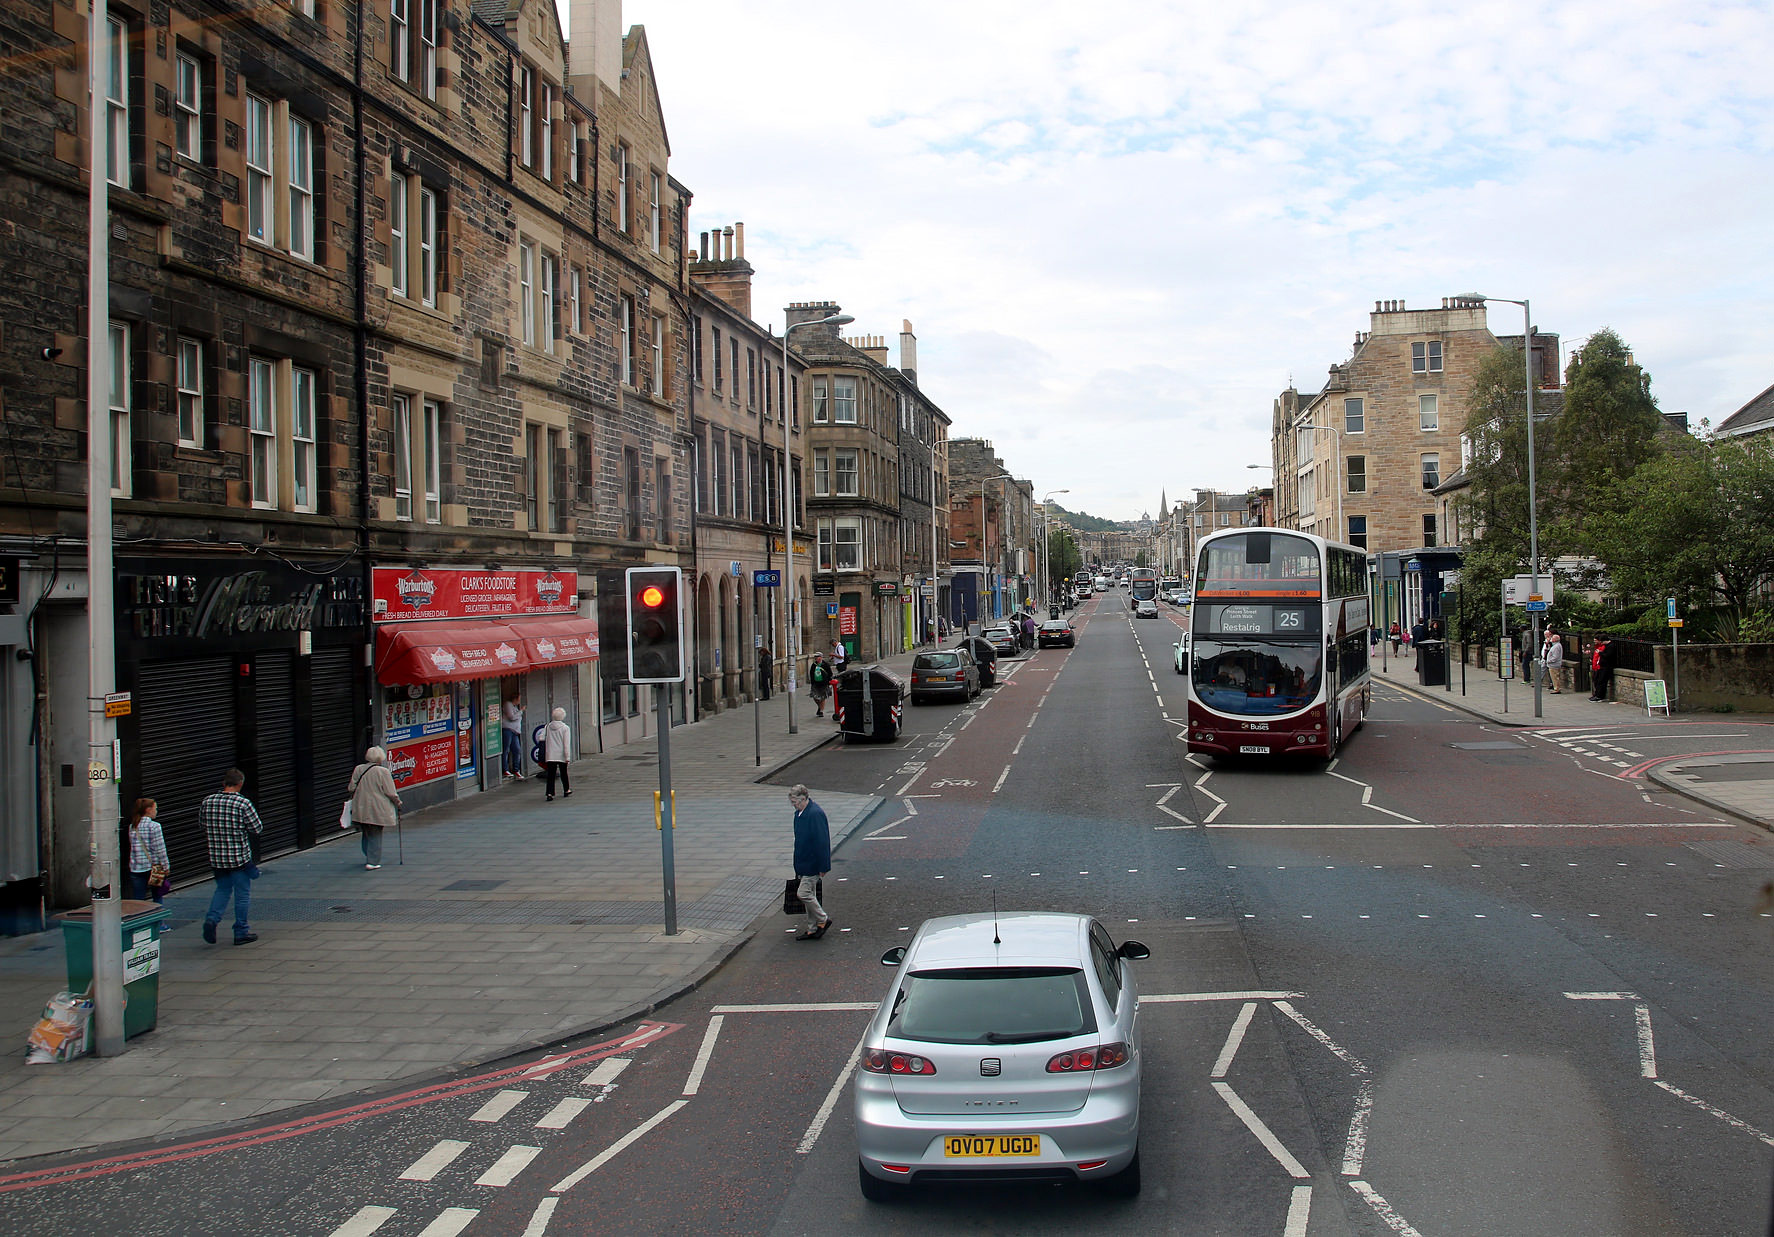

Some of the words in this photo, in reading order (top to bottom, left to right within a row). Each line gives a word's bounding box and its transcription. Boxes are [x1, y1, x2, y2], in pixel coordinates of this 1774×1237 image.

[398, 577, 435, 596] Warburtons
[485, 576, 517, 590] FOODSTORE
[537, 578, 562, 593] Warburtons
[460, 594, 478, 603] LICENSED
[397, 611, 412, 619] BREAD
[412, 610, 435, 618] DELIVERED
[436, 609, 449, 617] DAILY
[1280, 613, 1299, 627] 25
[1223, 623, 1261, 633] Restalrig
[1250, 723, 1270, 731] Buses
[951, 1138, 995, 1154] OV07
[1000, 1137, 1033, 1153] UGD
